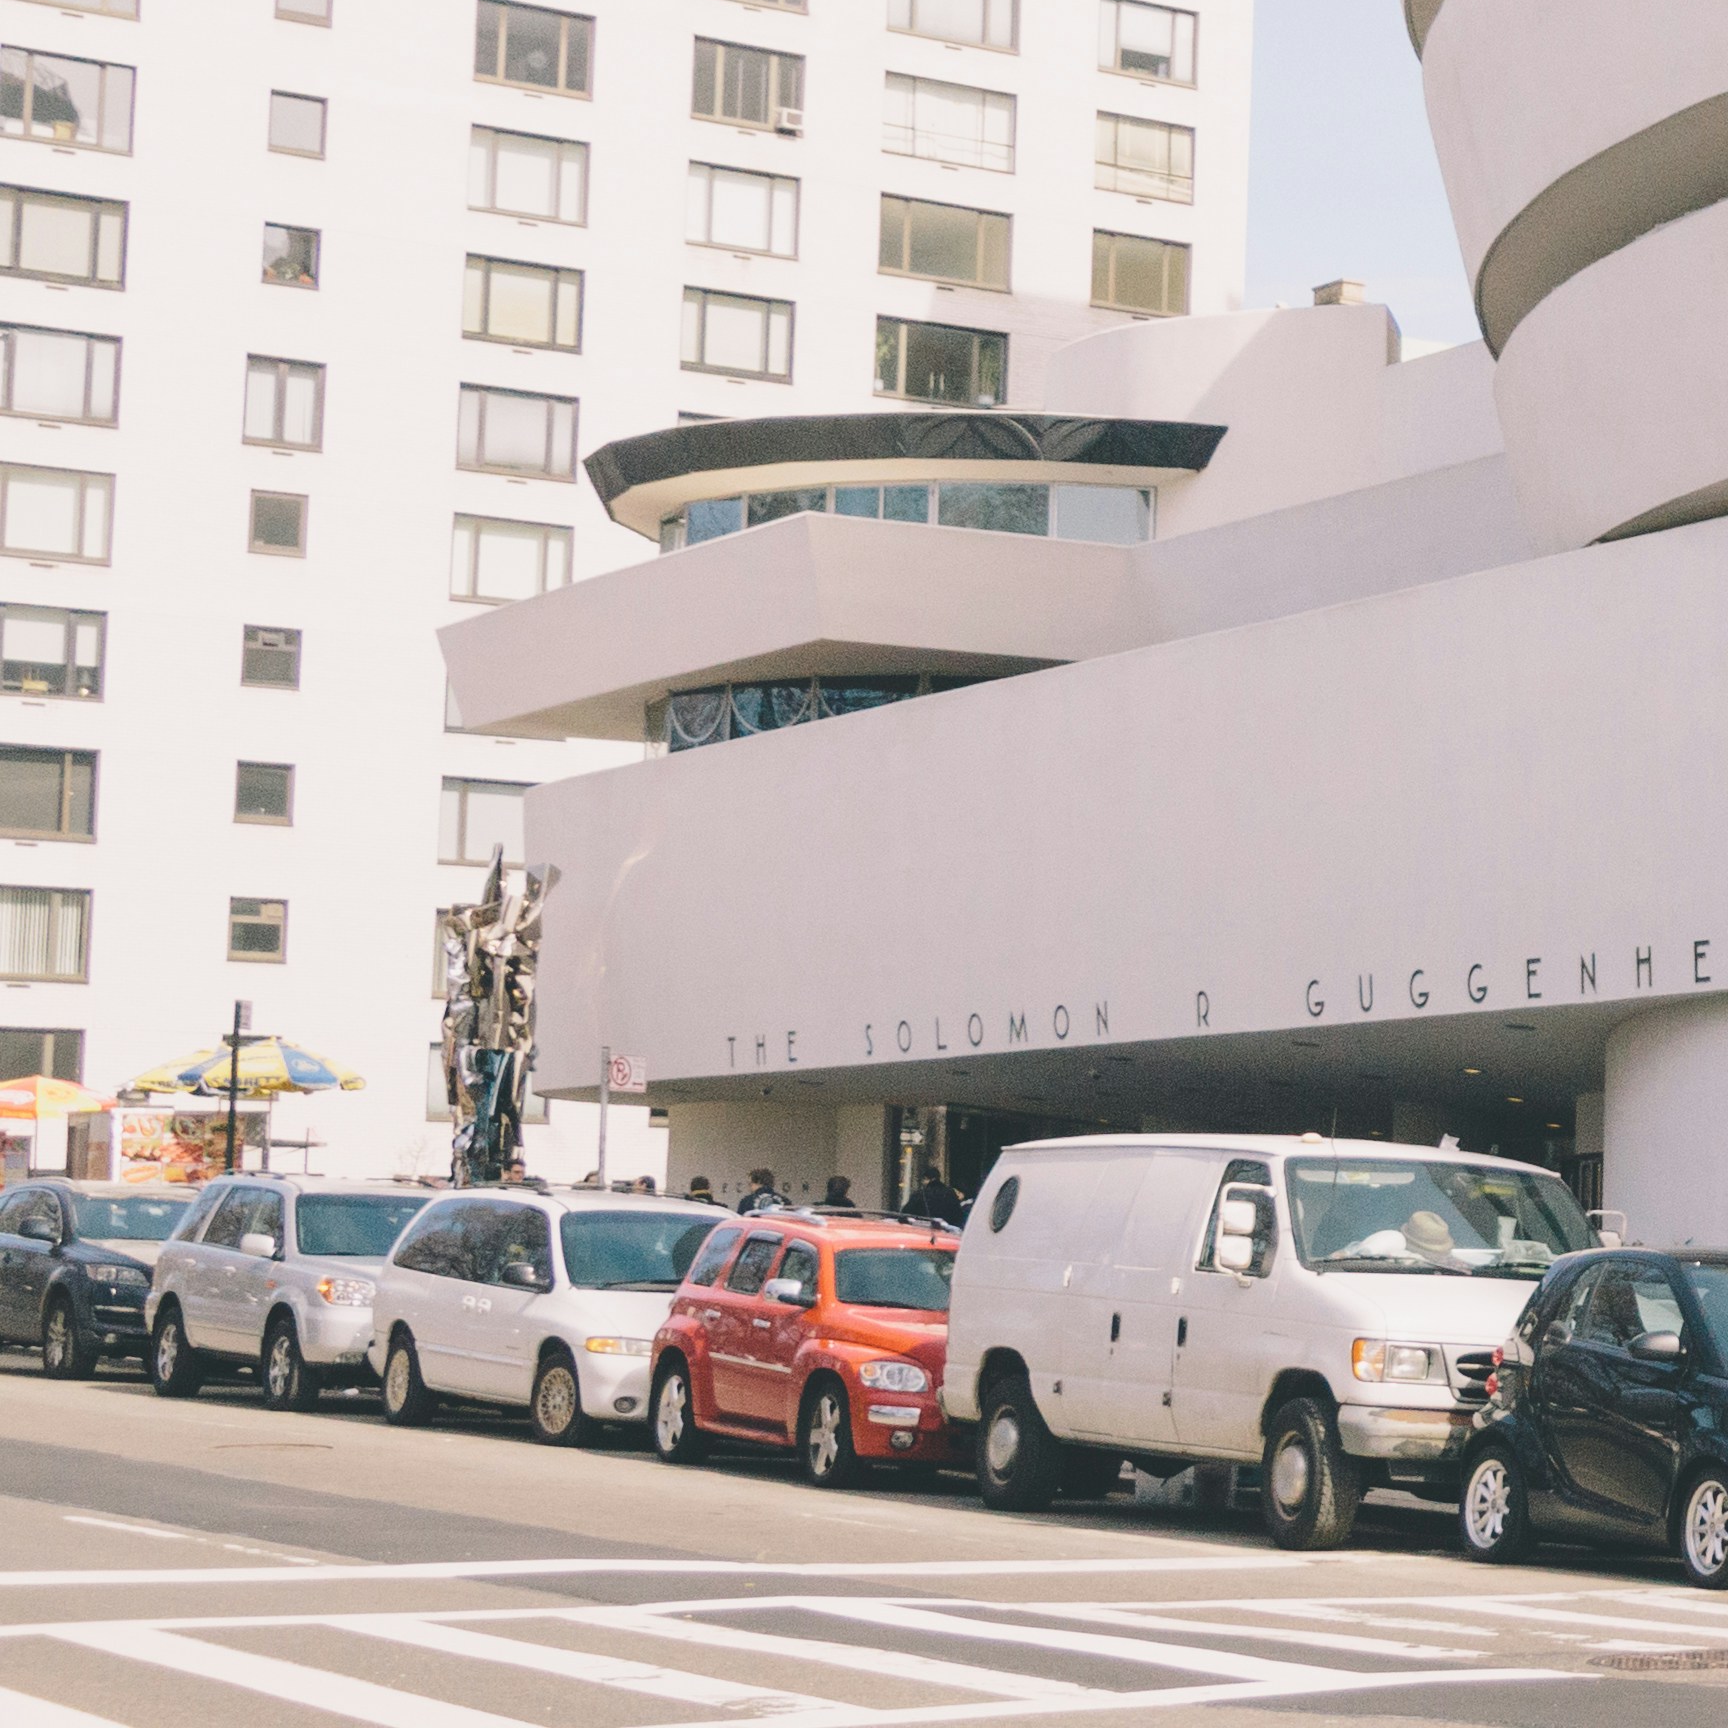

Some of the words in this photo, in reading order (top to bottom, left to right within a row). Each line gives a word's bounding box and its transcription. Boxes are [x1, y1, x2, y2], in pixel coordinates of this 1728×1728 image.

[725, 1029, 798, 1068] THE
[864, 1000, 1110, 1056] SOLOMON
[1196, 990, 1210, 1028] R
